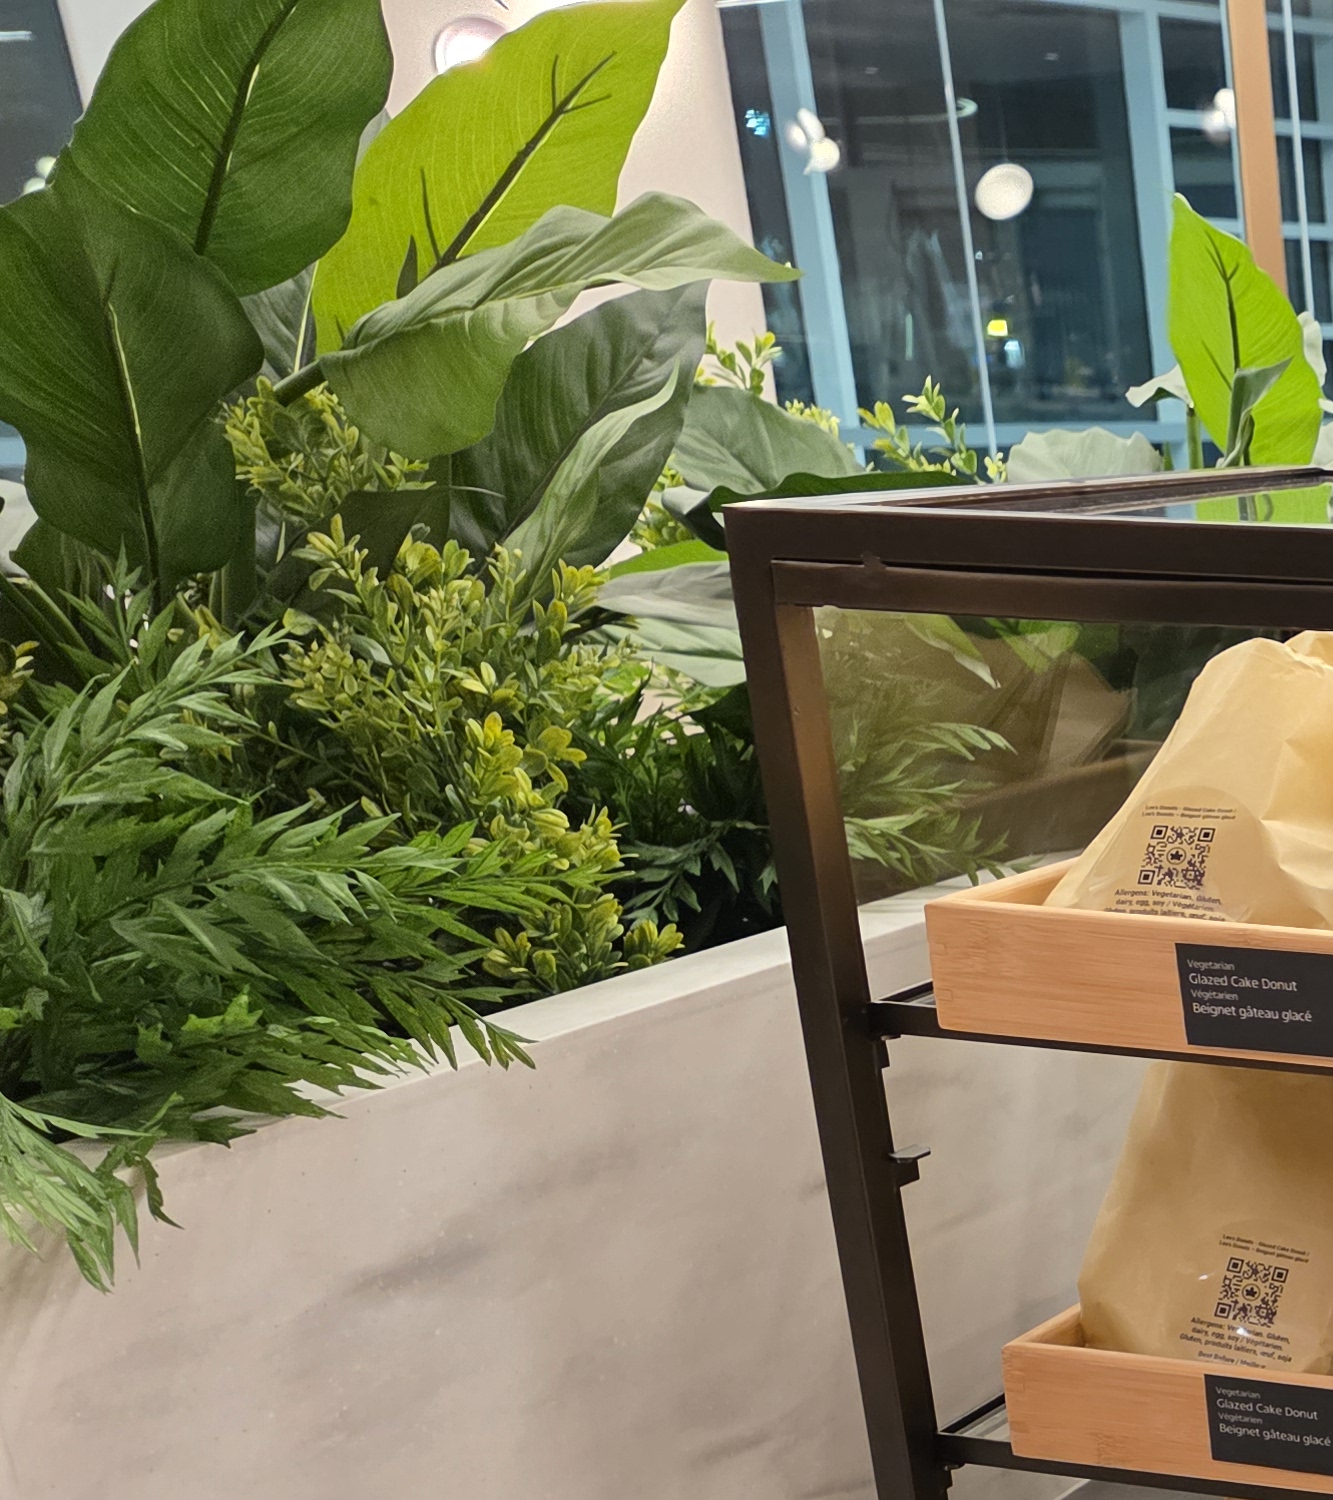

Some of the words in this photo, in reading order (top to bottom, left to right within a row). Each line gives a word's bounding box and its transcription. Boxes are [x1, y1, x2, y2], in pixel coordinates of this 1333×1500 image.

[1189, 973, 1228, 986] Glazed
[1230, 976, 1259, 988] Cake
[1261, 978, 1297, 991] Donut
[1192, 1002, 1236, 1017] Beignet
[1238, 1005, 1279, 1019] gâteau
[1281, 1009, 1312, 1023] glacé
[1216, 1398, 1253, 1411] Glazed
[1255, 1403, 1282, 1415] Cake
[1285, 1407, 1318, 1420] Donut
[1219, 1423, 1260, 1437] Beignet
[1262, 1429, 1300, 1442] gâteau
[1302, 1435, 1331, 1446] glacé
